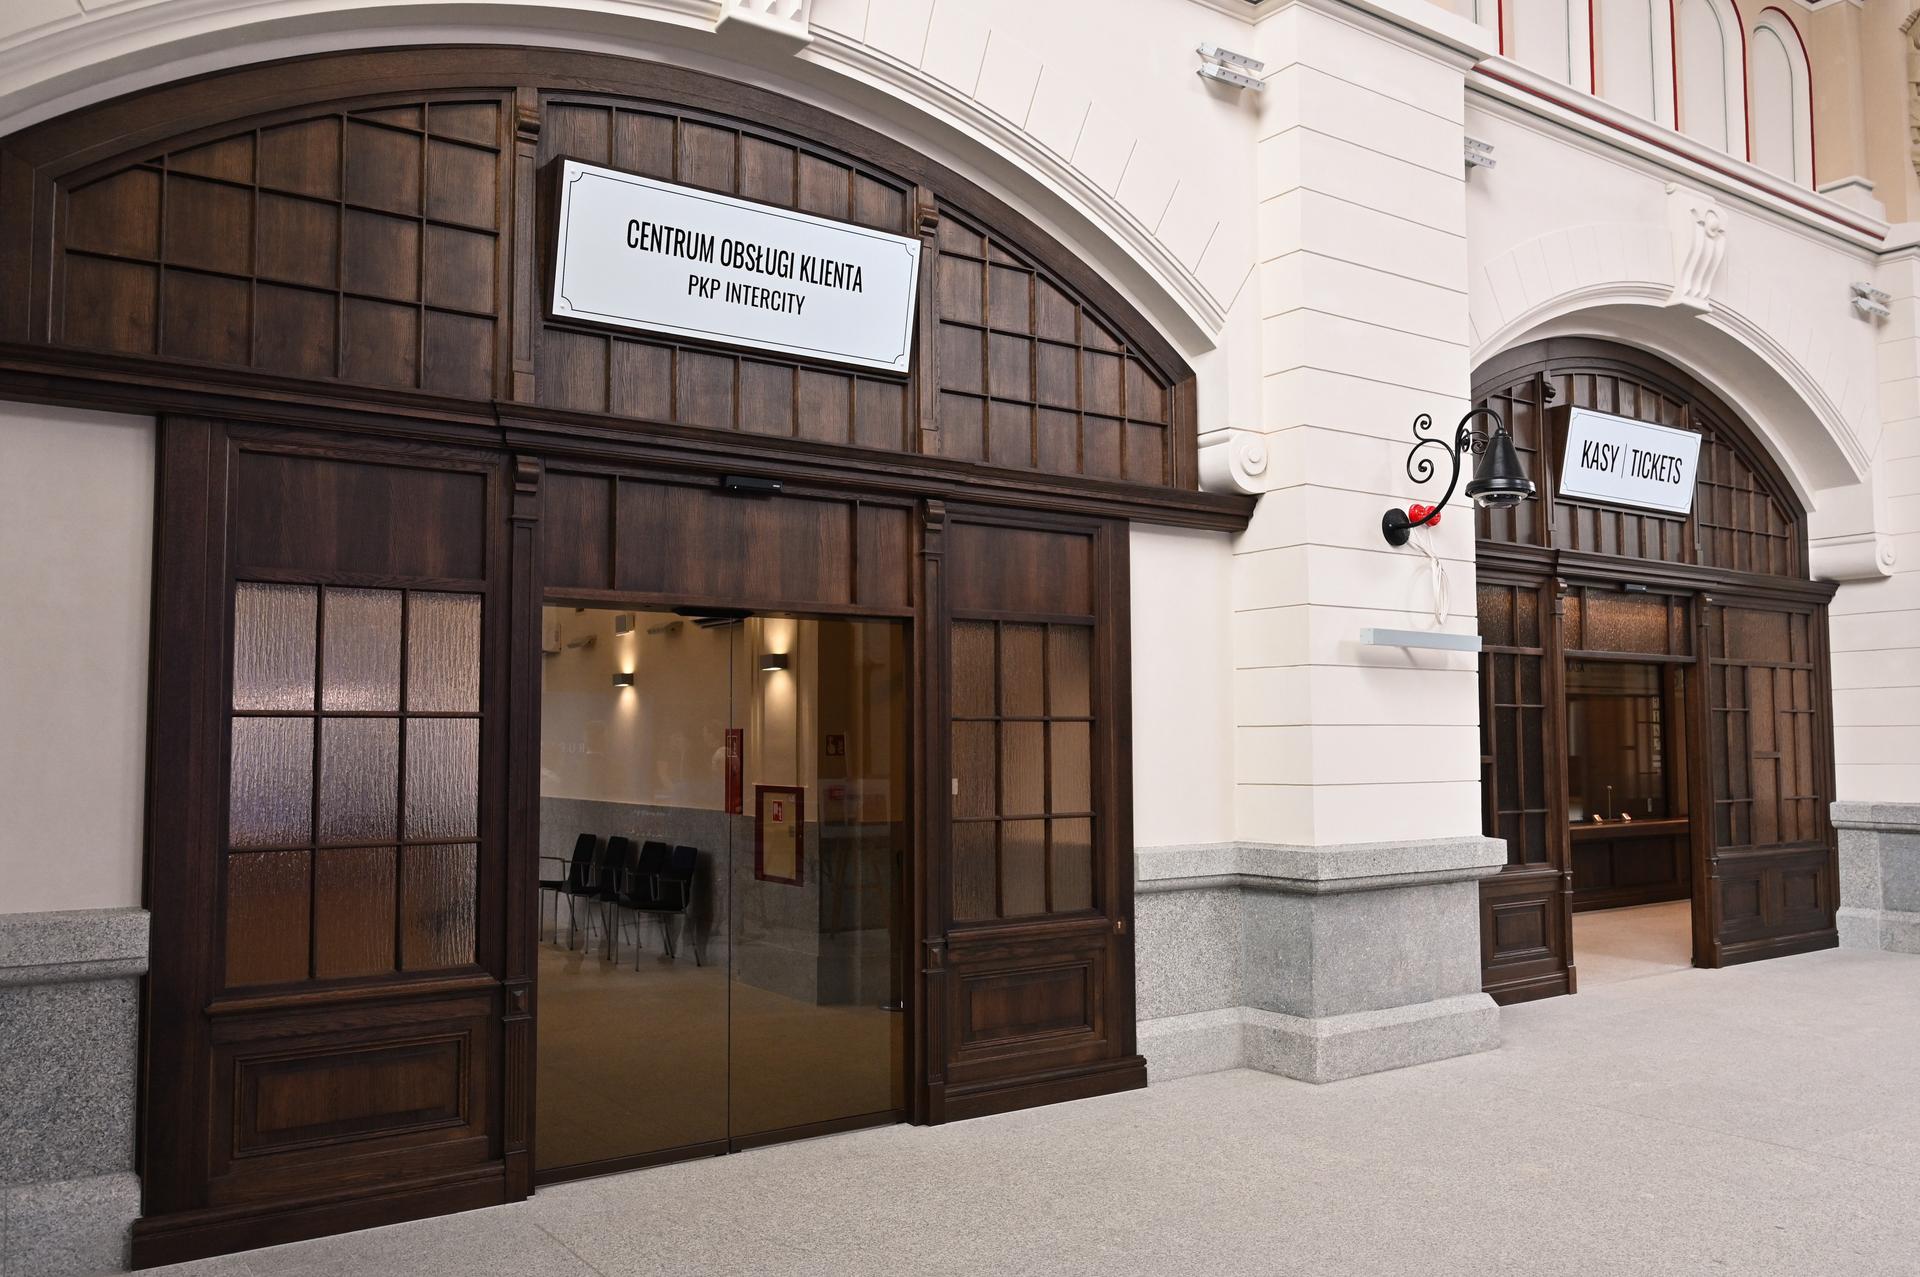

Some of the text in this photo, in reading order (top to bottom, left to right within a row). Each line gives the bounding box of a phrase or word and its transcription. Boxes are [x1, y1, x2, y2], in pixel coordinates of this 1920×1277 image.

[627, 219, 863, 293] CENTRUM OBSŁUGI KLIENTA
[688, 274, 806, 315] PKP INTERCITY
[1581, 440, 1682, 484] KASY TICKETS
